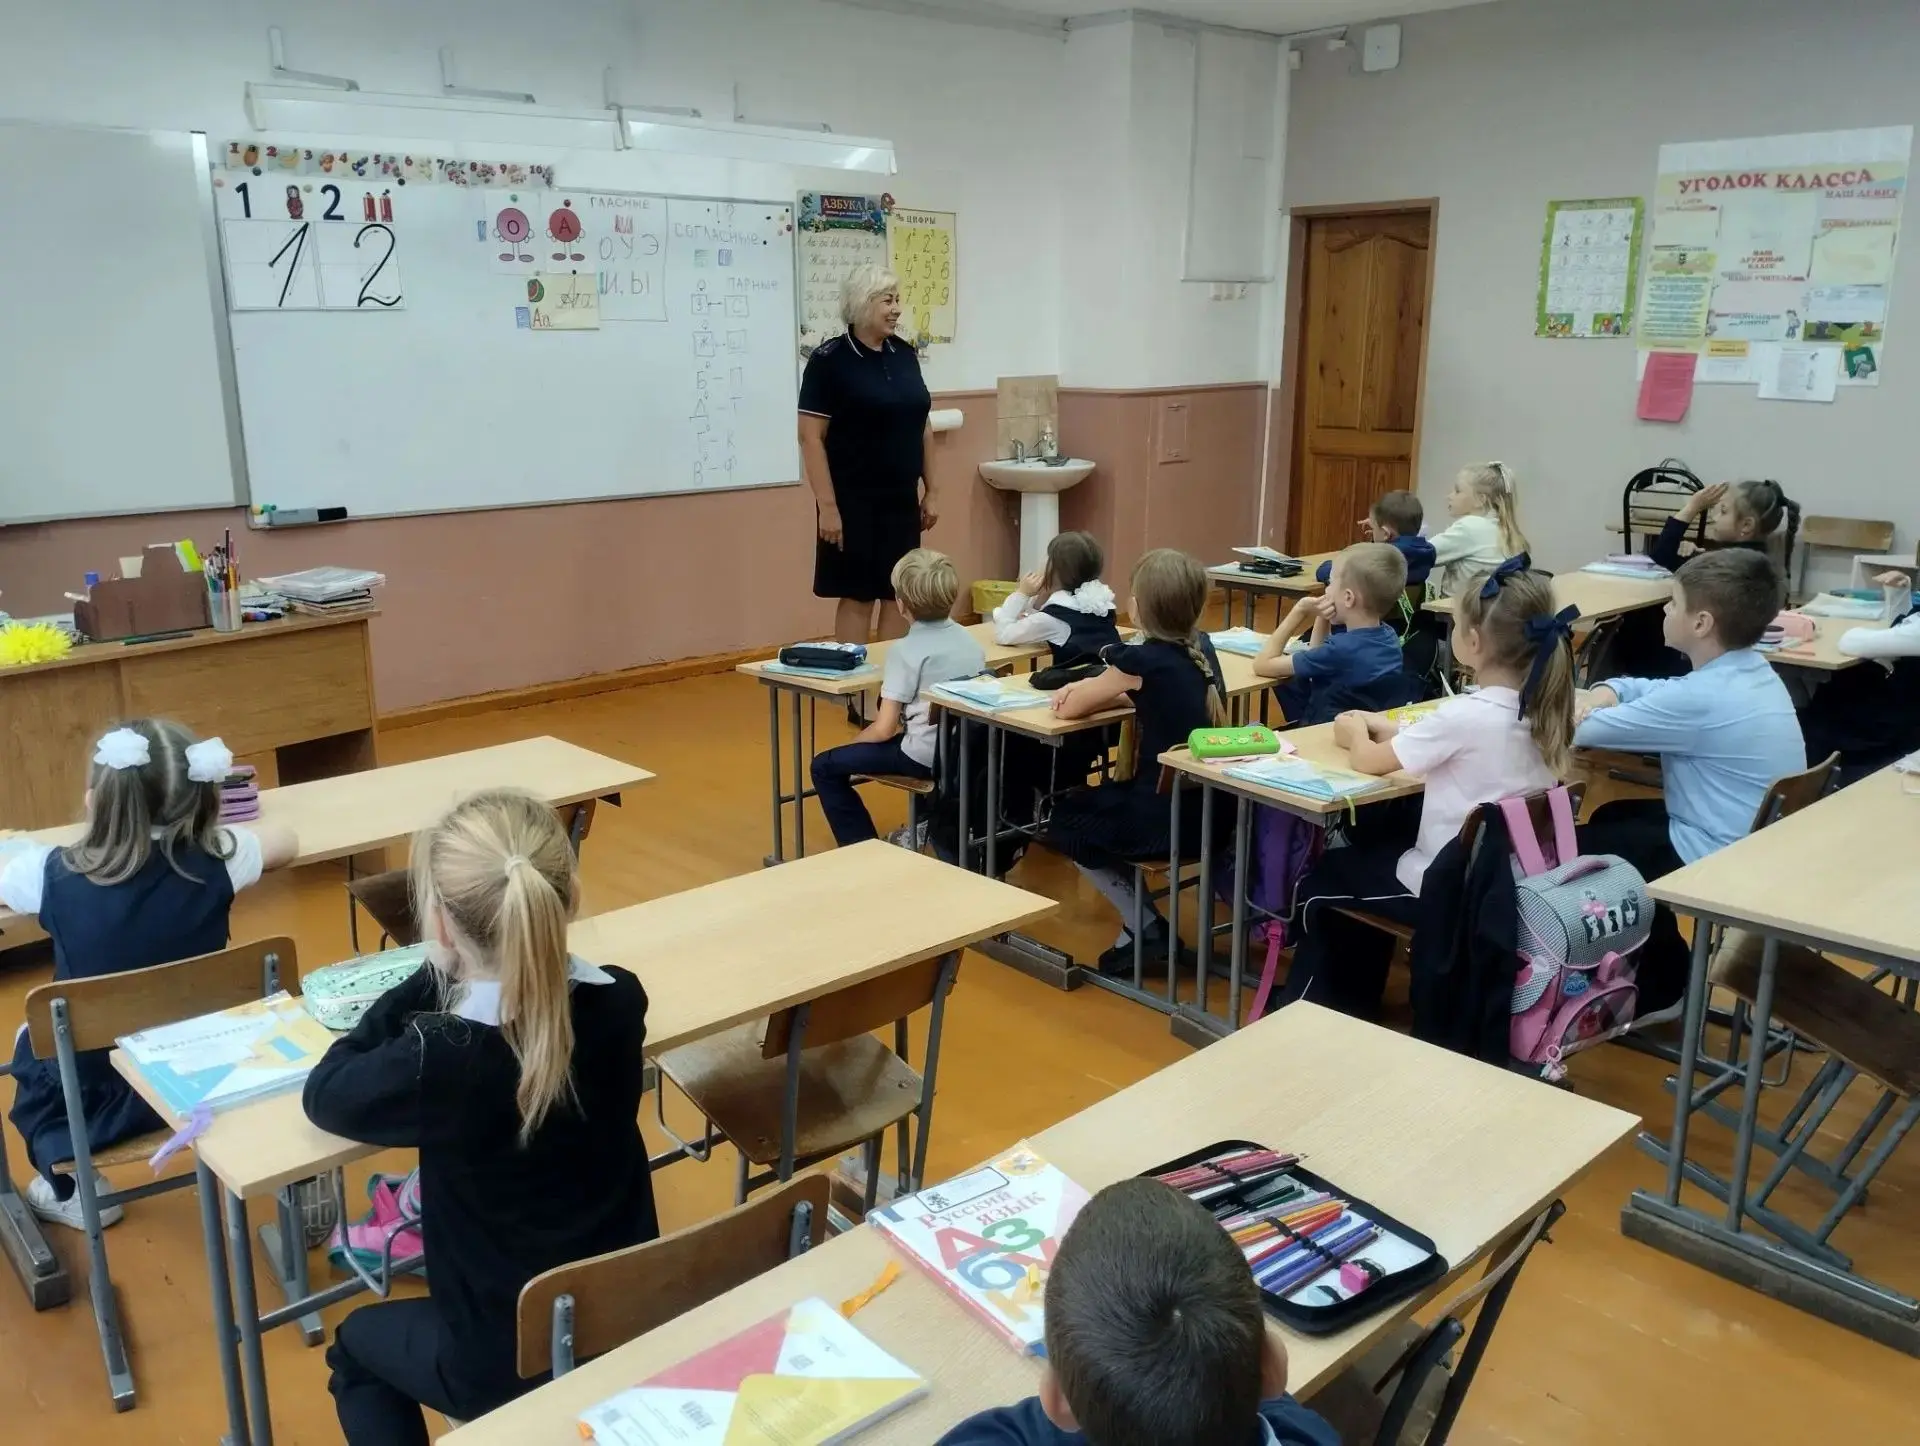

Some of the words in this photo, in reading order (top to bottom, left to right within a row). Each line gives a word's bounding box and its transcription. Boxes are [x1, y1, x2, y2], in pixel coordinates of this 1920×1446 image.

[230, 142, 240, 154] 1
[266, 145, 277, 157] 2
[304, 150, 313, 161] 3
[339, 152, 348, 163] 4
[373, 153, 381, 165] 5
[404, 155, 413, 166] 6
[437, 159, 445, 170] 7
[470, 162, 478, 173] 8
[500, 163, 507, 174] 9
[529, 165, 543, 175] 10
[1678, 172, 1767, 194] УГОЛОК
[1775, 168, 1875, 190] КЛАССА
[234, 182, 251, 218] 1
[320, 184, 345, 221] 2
[590, 196, 650, 210] ГЛАСНЫЕ
[823, 197, 864, 211] АЗБУКА
[558, 216, 573, 233] А
[907, 215, 937, 226] ЦИФРЫ
[641, 233, 659, 256] Э
[922, 234, 931, 253] 2
[941, 235, 950, 255] 3
[268, 221, 309, 307] 1
[354, 223, 401, 307] 2
[923, 260, 932, 279] 5
[941, 261, 950, 279] 6
[631, 271, 650, 295] Ы
[922, 285, 931, 305] 8
[941, 287, 949, 306] 9
